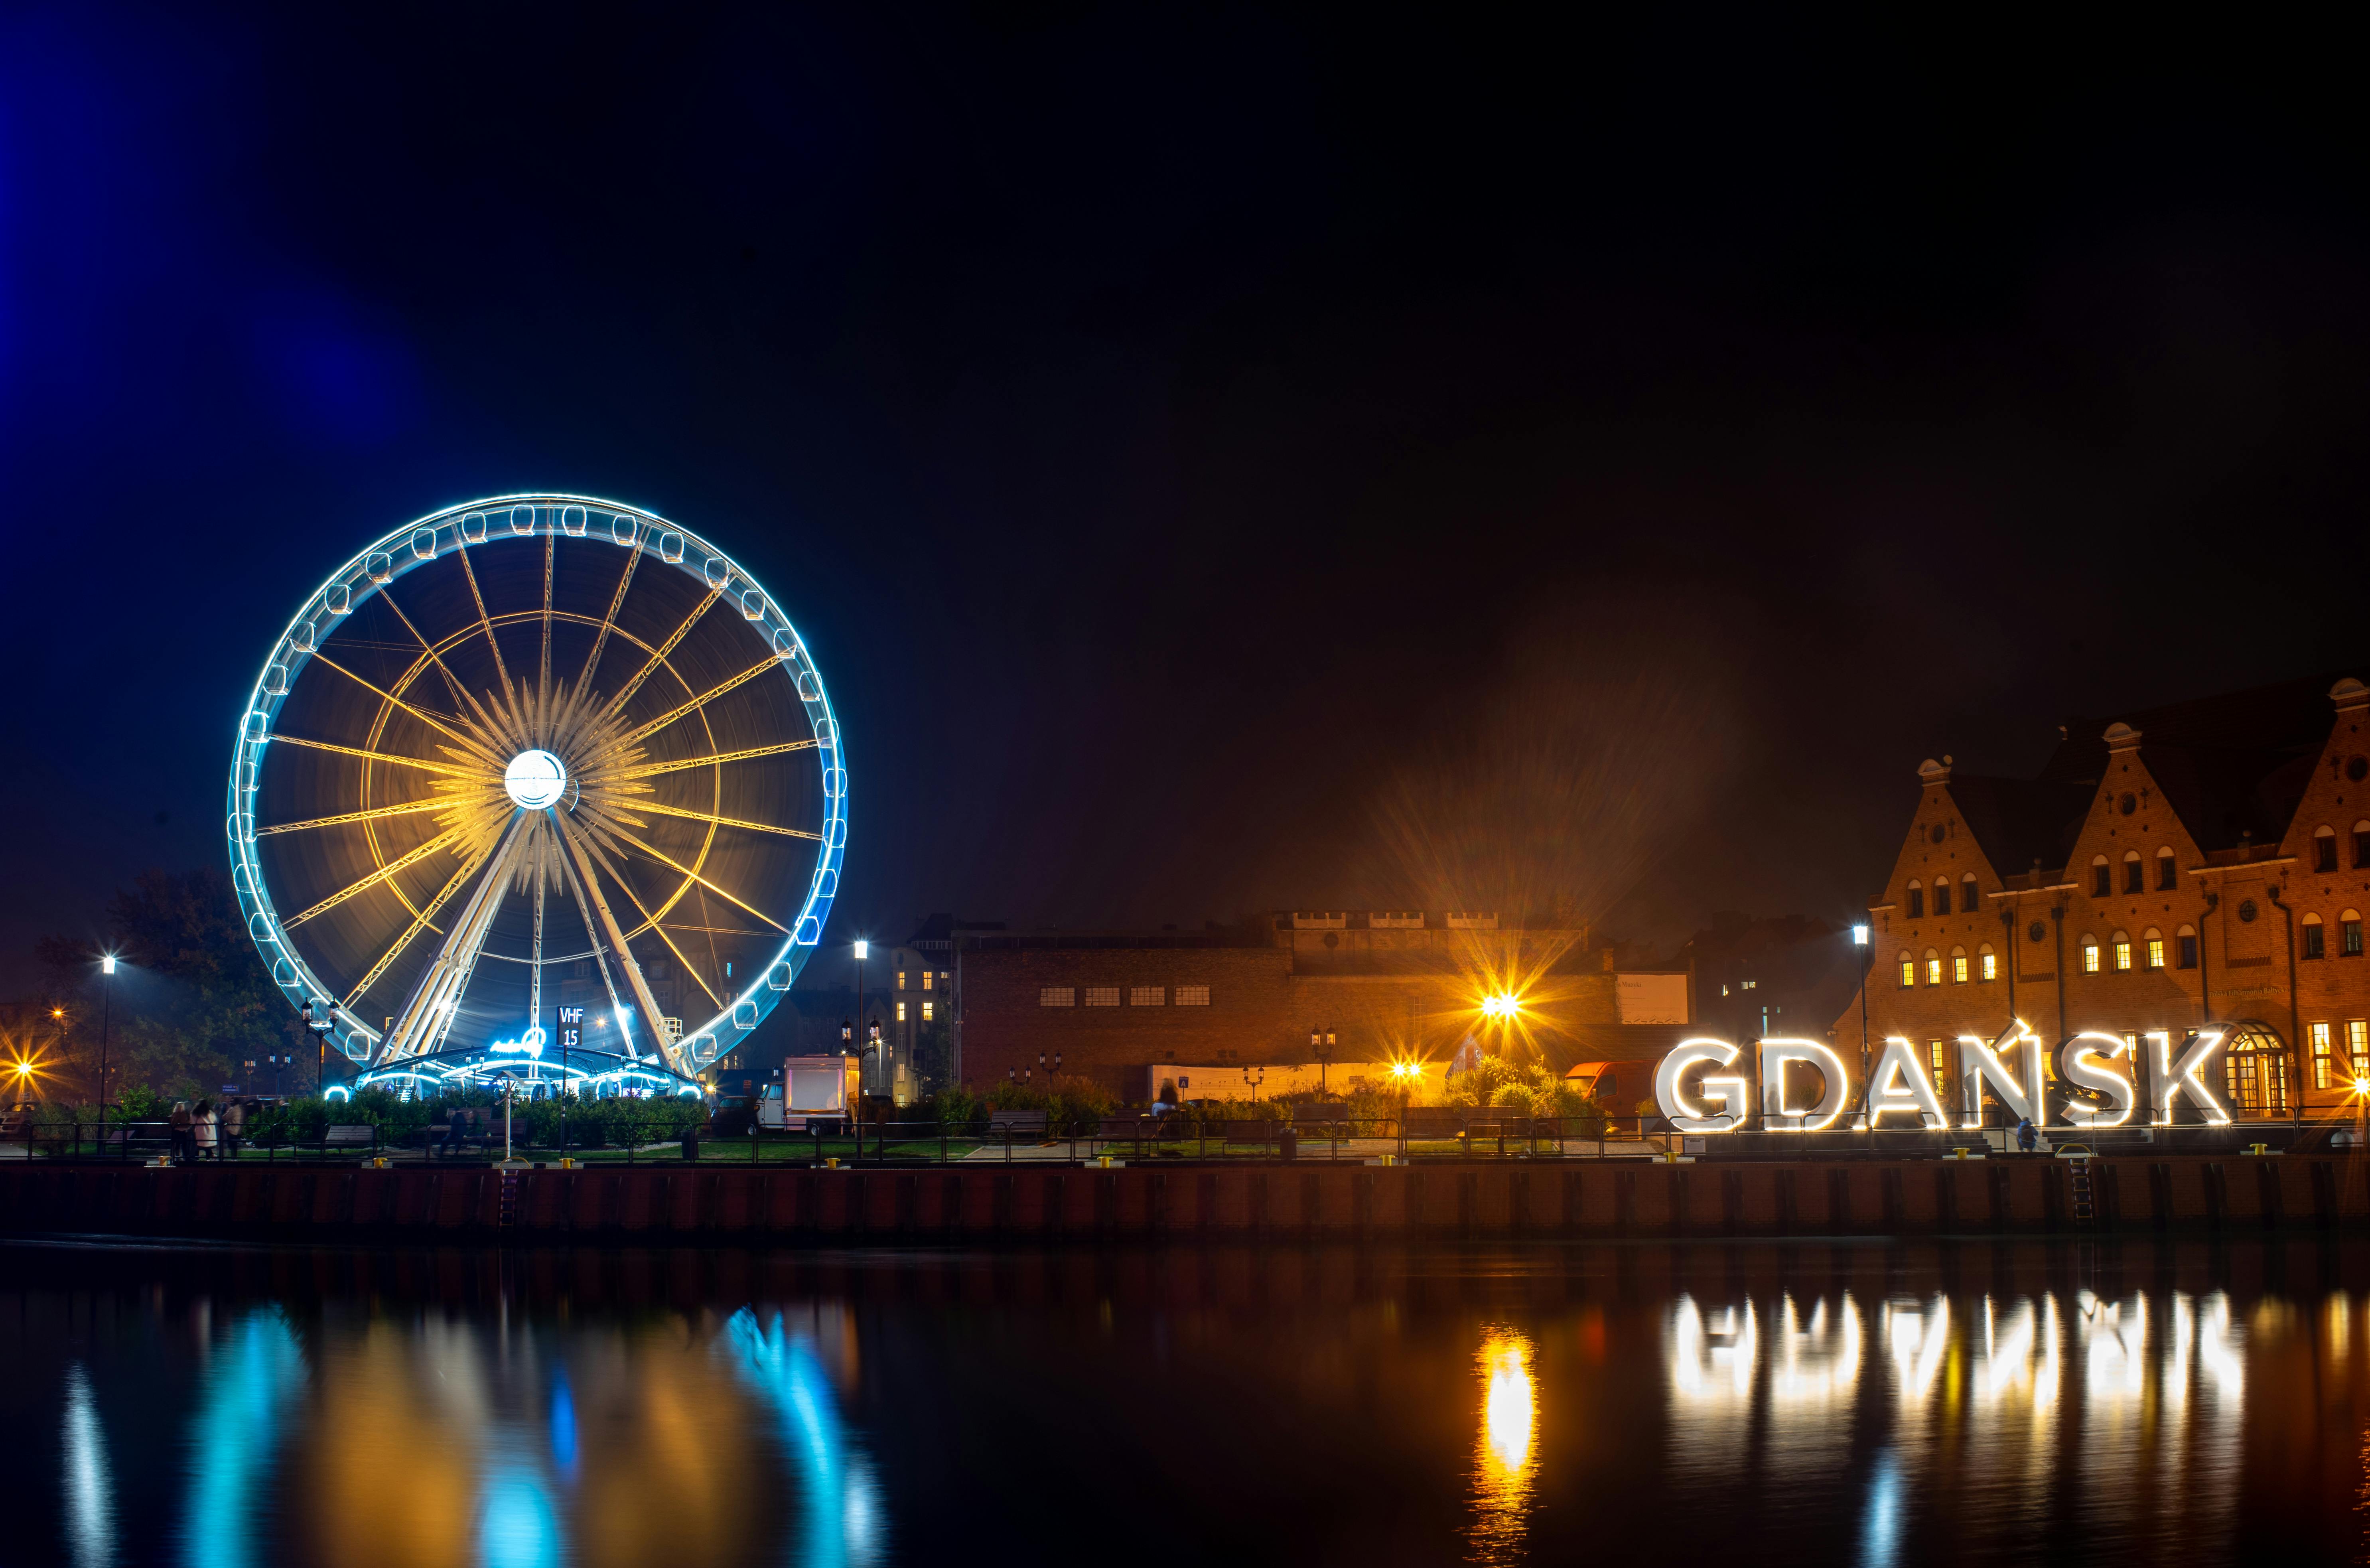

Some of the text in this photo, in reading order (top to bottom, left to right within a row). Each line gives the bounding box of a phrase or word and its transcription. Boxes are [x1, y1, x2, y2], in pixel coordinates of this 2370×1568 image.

[2264, 986, 2288, 995] Bałtycka
[560, 1007, 584, 1023] VHF
[564, 1030, 578, 1045] 15
[2287, 1053, 2294, 1063] B
[1652, 1018, 2231, 1132] GDAŃSK
